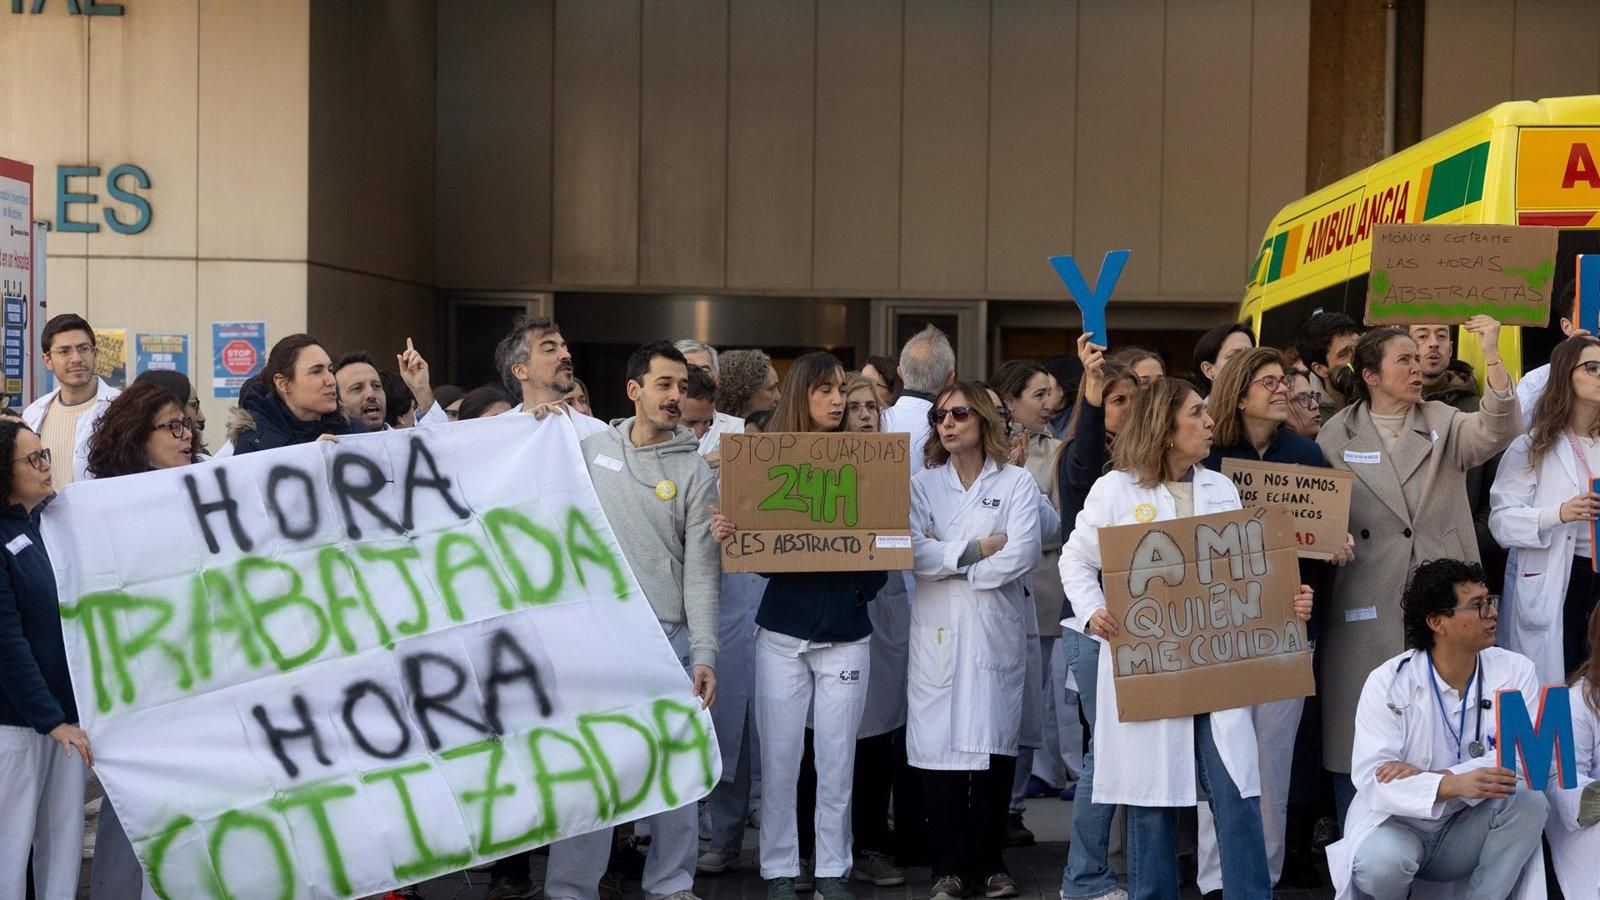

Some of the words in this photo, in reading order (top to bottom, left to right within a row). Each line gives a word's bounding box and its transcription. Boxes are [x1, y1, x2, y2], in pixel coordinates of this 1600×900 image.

[1303, 180, 1410, 265] AMBULANCIA
[1381, 285, 1544, 305] ABSTRACTAS
[1386, 257, 1420, 270] LAS
[1436, 255, 1504, 272] HORAS
[227, 349, 252, 358] STOP
[726, 433, 797, 465] STOP
[809, 437, 907, 464] GUARDIAS
[1232, 471, 1253, 486] NO
[1264, 473, 1289, 487] NOS
[183, 436, 471, 554] HORA
[757, 462, 859, 528] 24H
[1127, 528, 1186, 598] A
[60, 505, 632, 713] TRABAJADA
[1116, 640, 1183, 678] ME
[1189, 620, 1301, 666] CUIDA
[252, 628, 554, 778] HORA
[140, 698, 716, 900] COTIZADA
